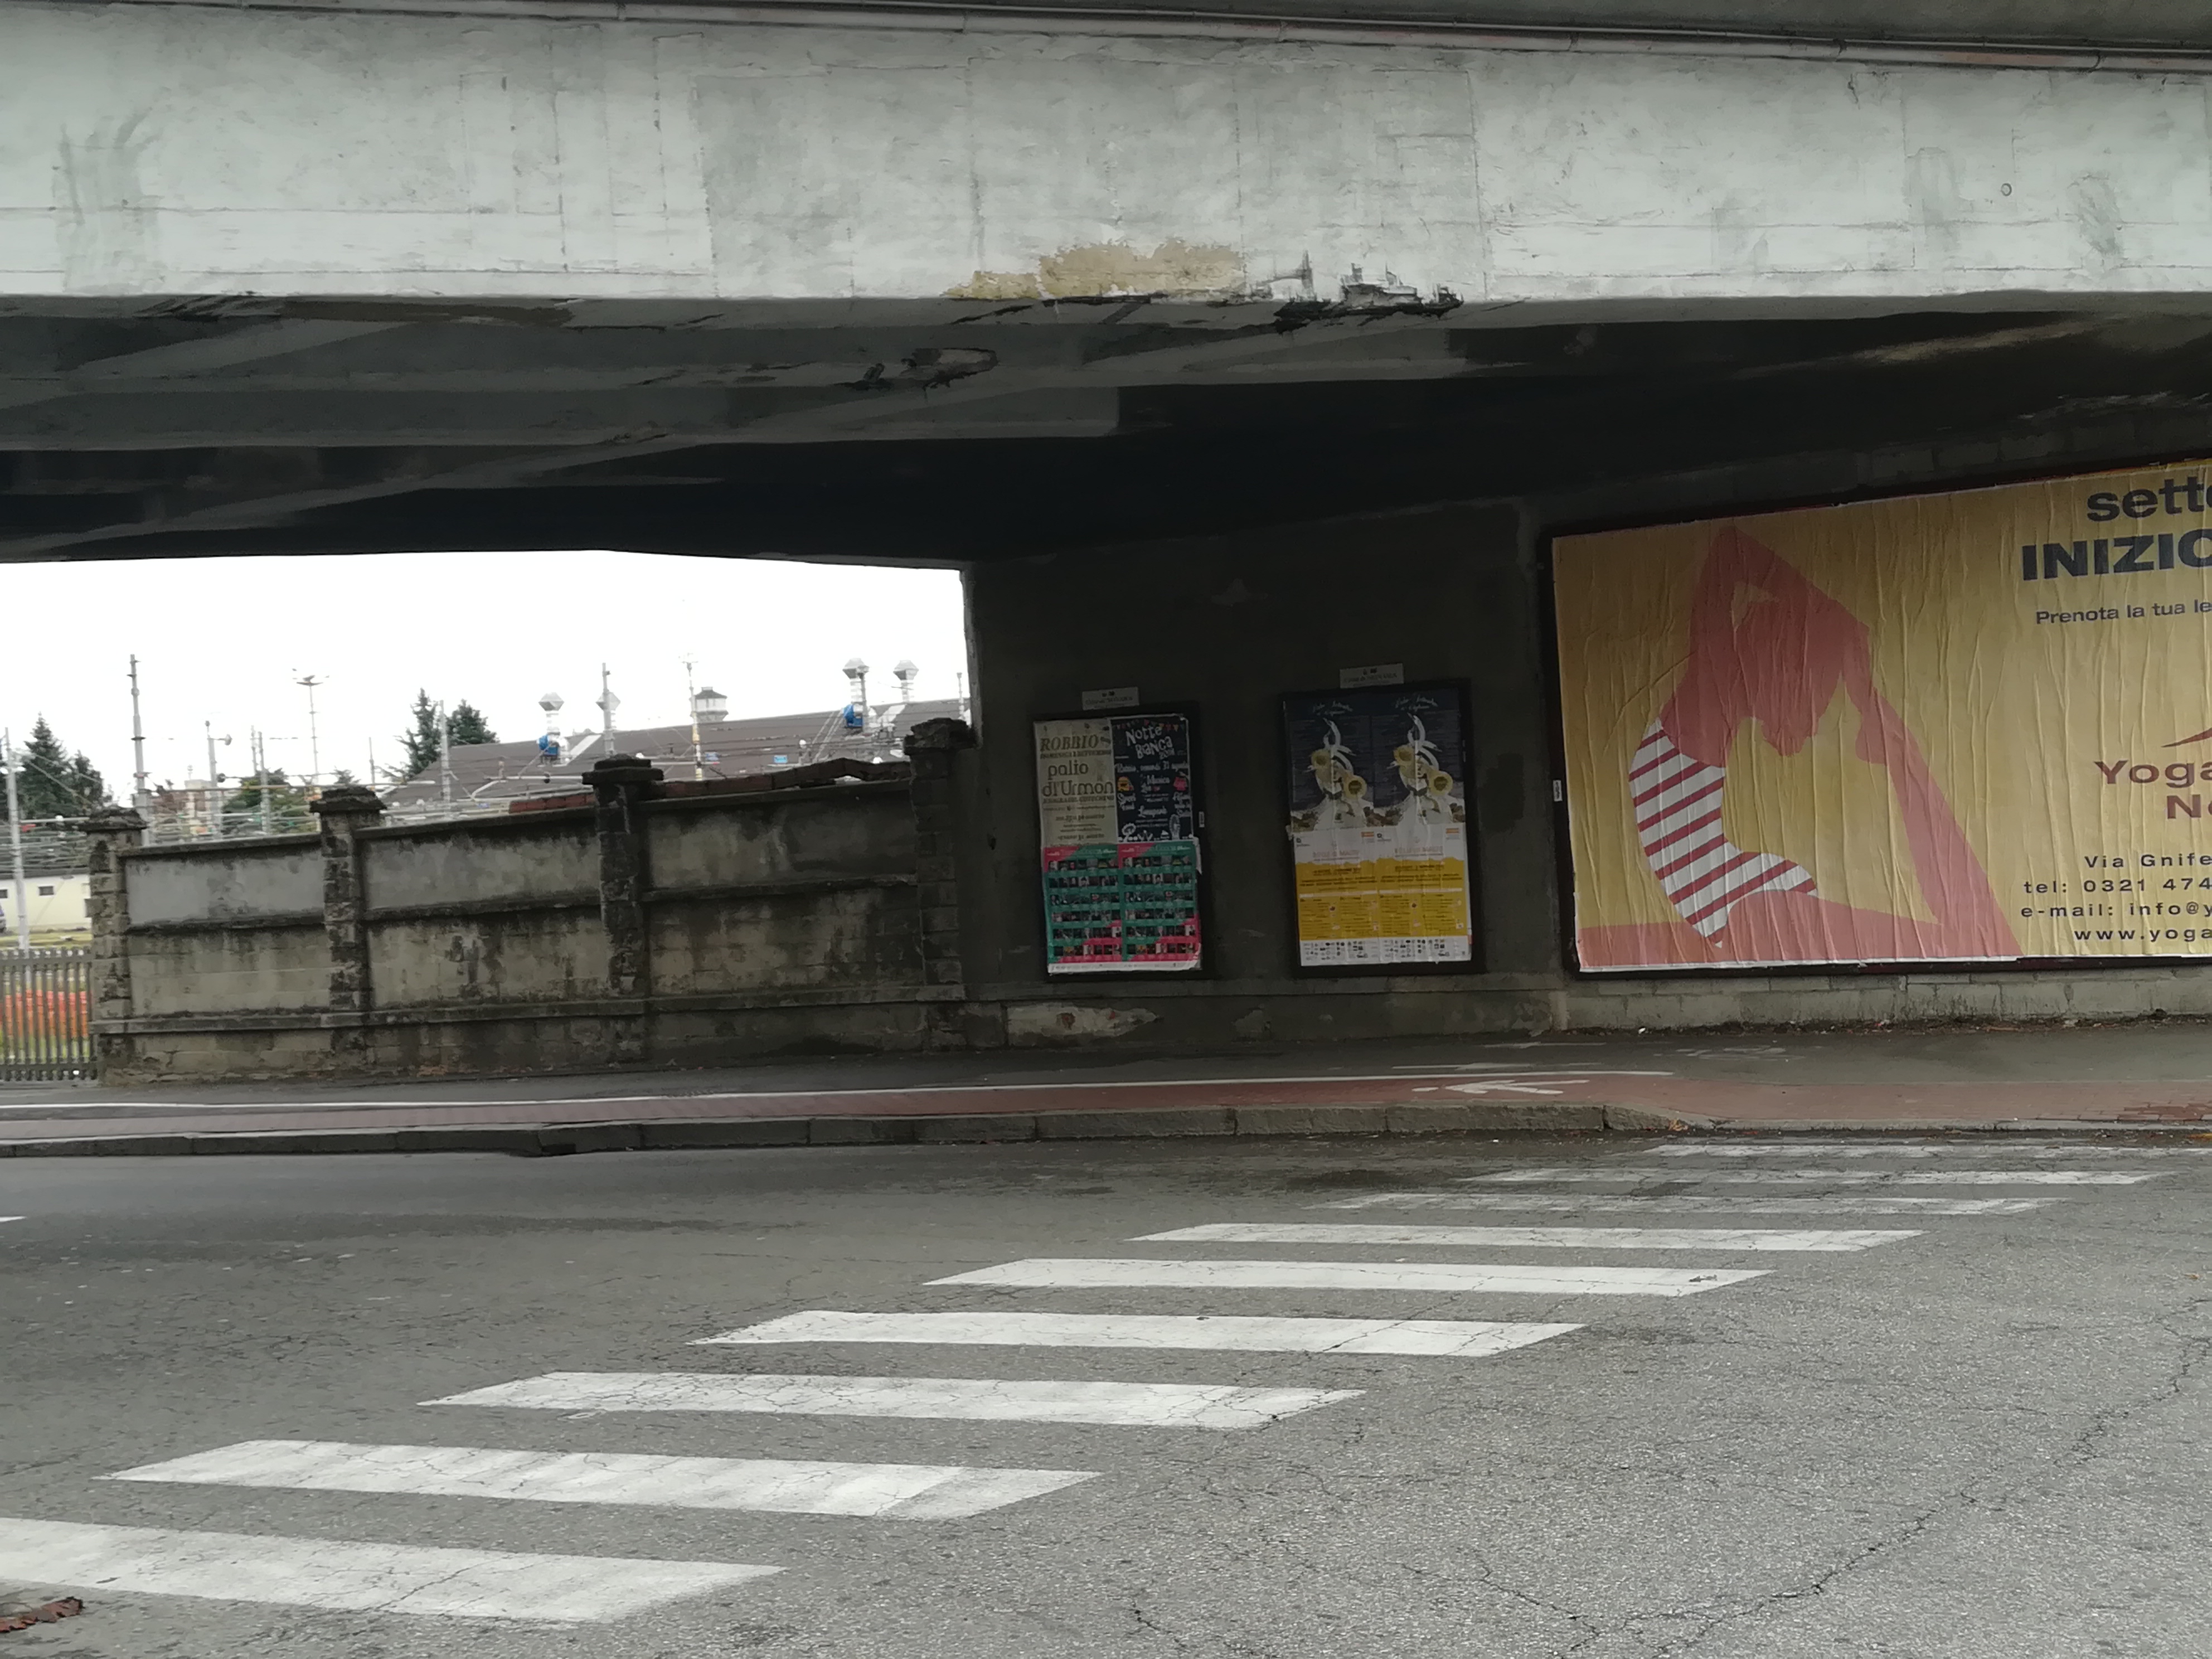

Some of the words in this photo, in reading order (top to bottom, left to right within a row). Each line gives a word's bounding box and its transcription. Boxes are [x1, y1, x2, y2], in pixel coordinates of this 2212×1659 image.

[2087, 477, 2212, 522] sett
[2036, 607, 2119, 624] Prenota
[2127, 605, 2145, 618] la
[2152, 603, 2185, 616] tua
[1040, 734, 1099, 751] ROBBIO
[1047, 760, 1089, 780] palio
[2166, 794, 2212, 819] N
[2085, 856, 2124, 868] Via
[2024, 881, 2067, 894] tel:
[2083, 880, 2146, 892] 0321
[2021, 904, 2113, 918] e-mail:
